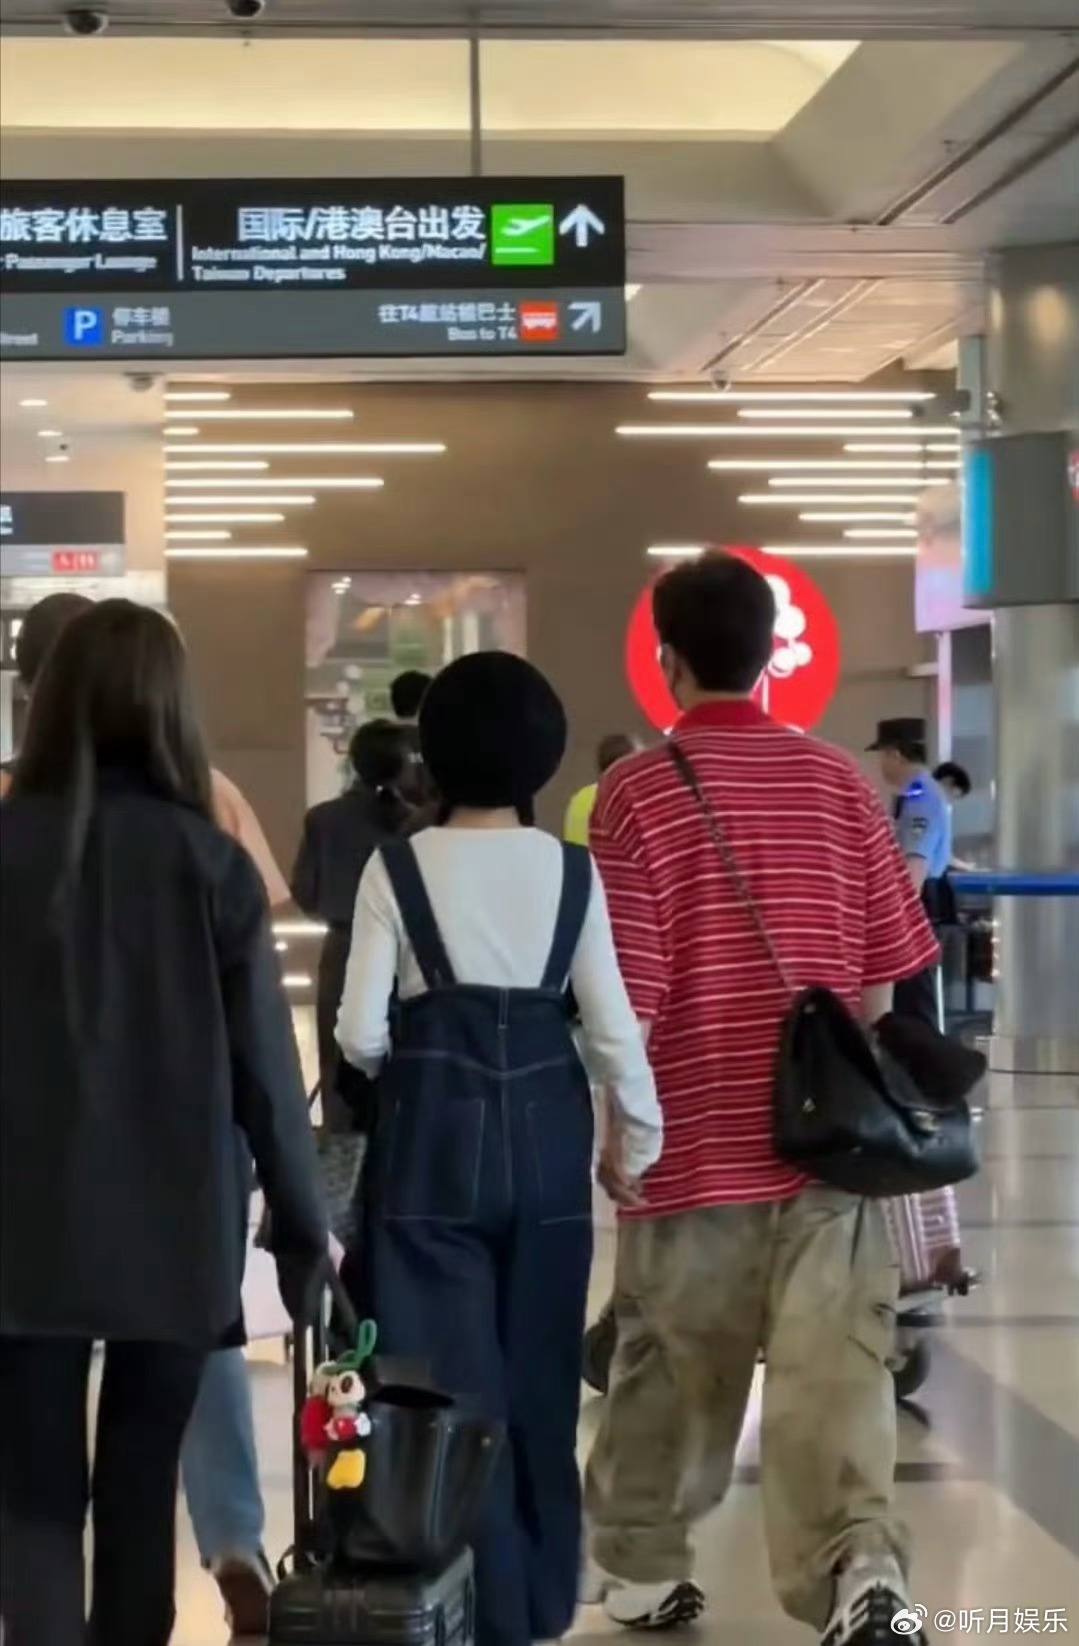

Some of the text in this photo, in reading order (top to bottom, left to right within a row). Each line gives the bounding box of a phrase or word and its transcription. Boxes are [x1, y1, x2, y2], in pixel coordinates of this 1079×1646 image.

[0, 207, 168, 242] 旅客休息室
[237, 205, 487, 242] 国际/港澳台出发
[192, 245, 297, 261] International
[299, 244, 331, 260] and
[333, 244, 377, 264] Hong
[73, 309, 98, 341] P
[479, 326, 496, 341] to
[497, 325, 518, 341] T4
[111, 330, 174, 348] Parking
